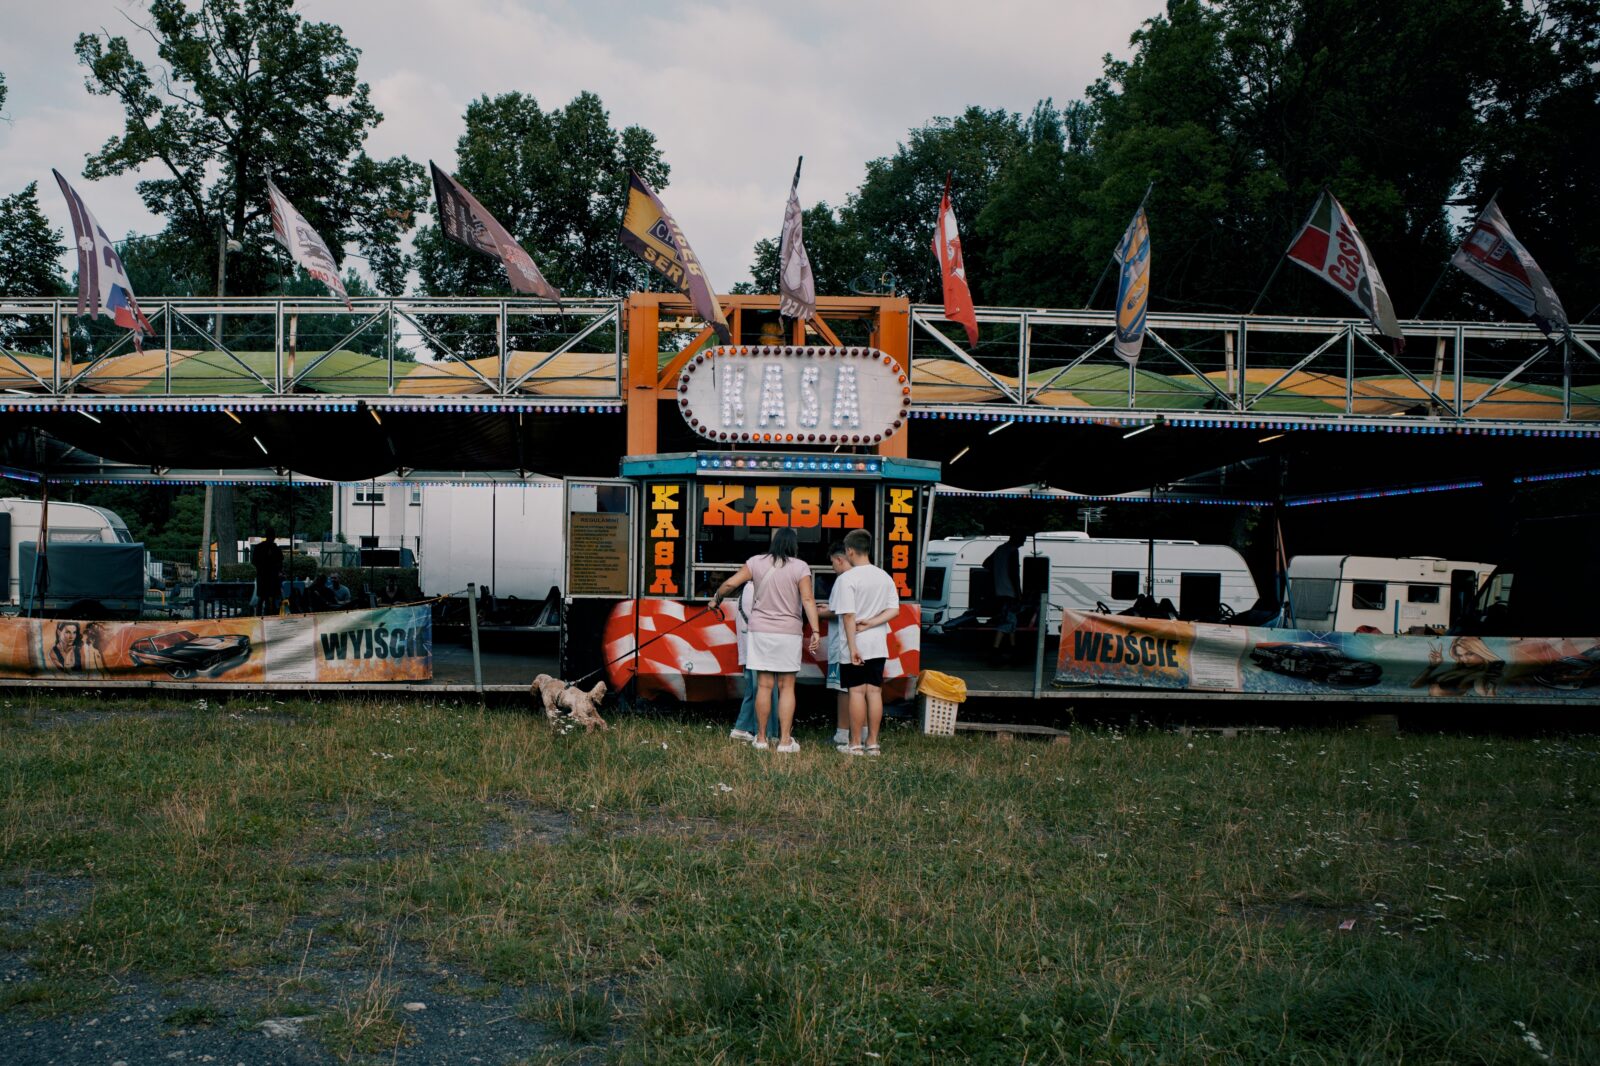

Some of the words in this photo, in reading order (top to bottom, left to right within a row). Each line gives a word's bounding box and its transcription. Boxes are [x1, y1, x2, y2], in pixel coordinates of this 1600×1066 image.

[720, 363, 860, 428] KASA
[703, 484, 865, 529] KASA
[649, 485, 680, 594] KASA
[889, 488, 913, 597] KASA
[1074, 630, 1180, 668] WEJŚCIE
